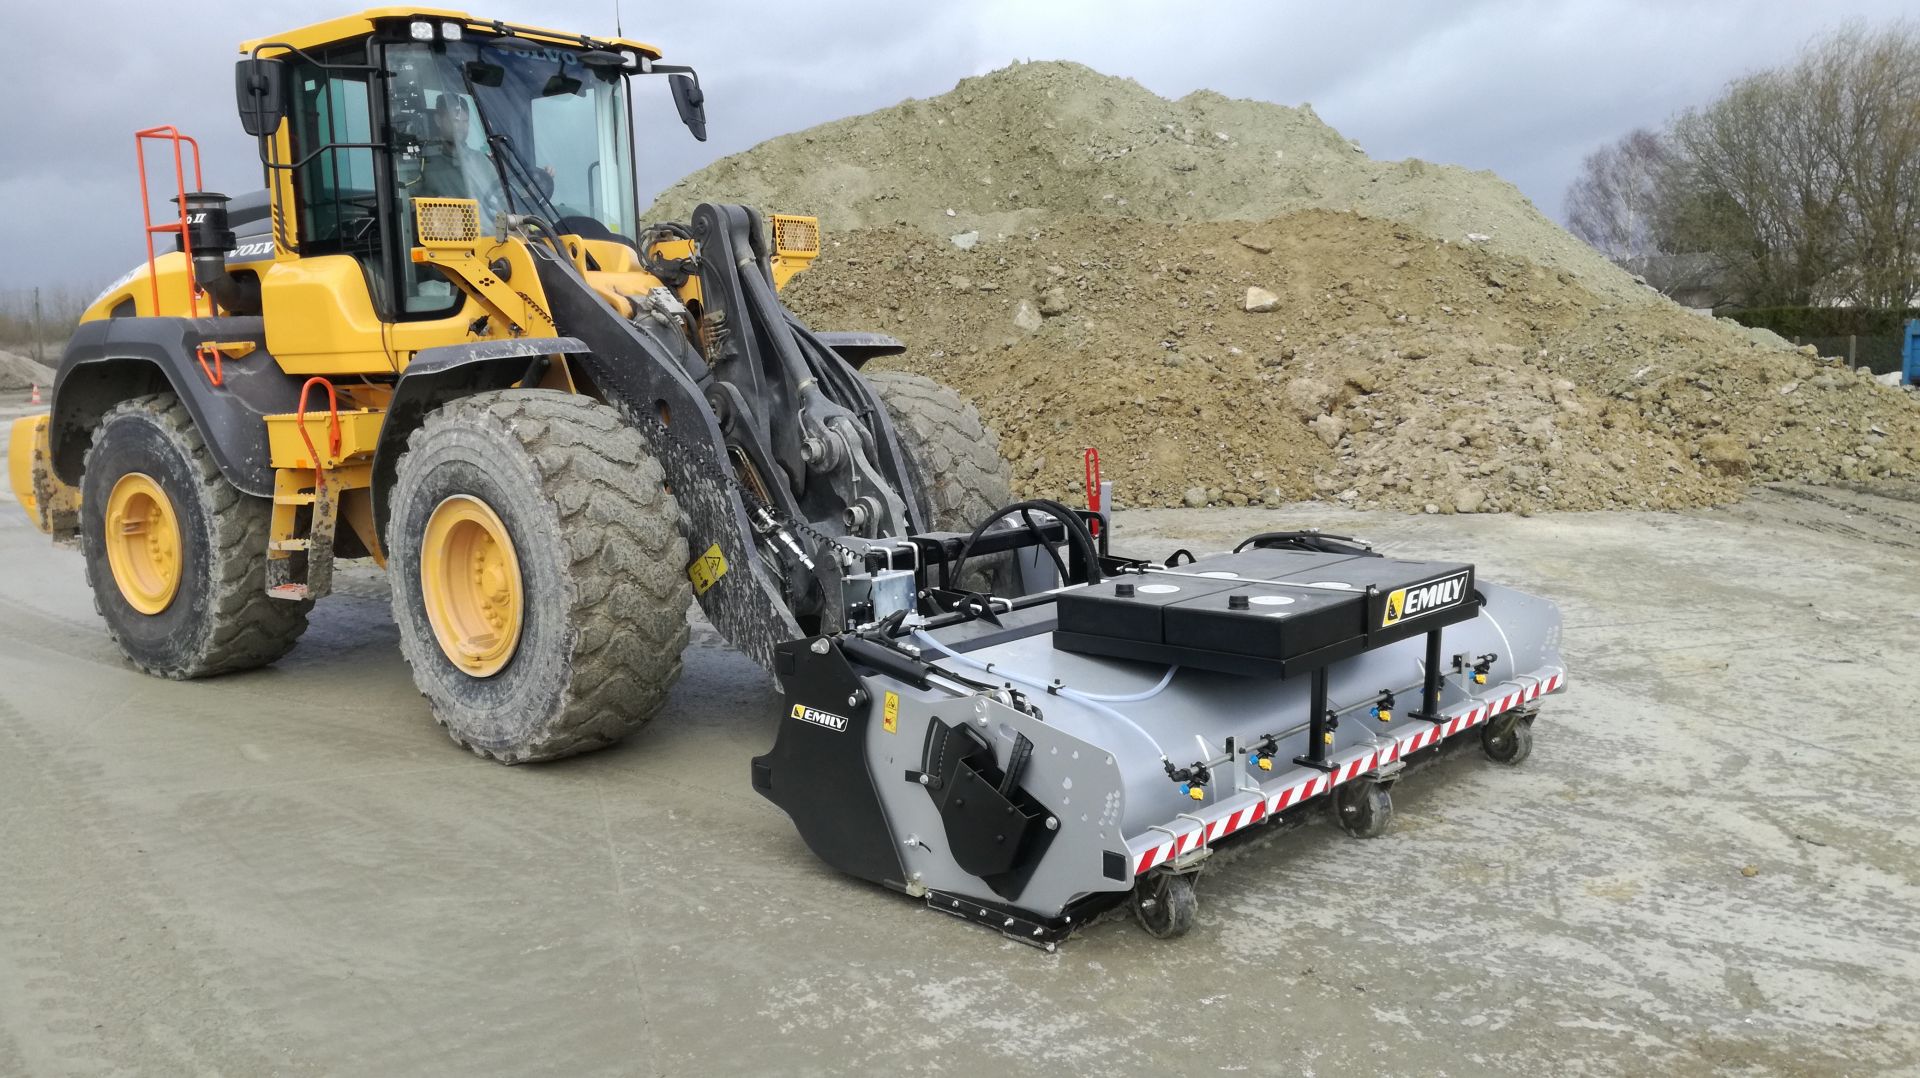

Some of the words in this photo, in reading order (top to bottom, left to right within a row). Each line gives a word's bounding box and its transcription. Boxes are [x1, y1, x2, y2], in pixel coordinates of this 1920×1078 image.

[229, 241, 275, 258] VOLV
[1404, 576, 1465, 615] EMILY
[804, 709, 846, 729] EMILY
